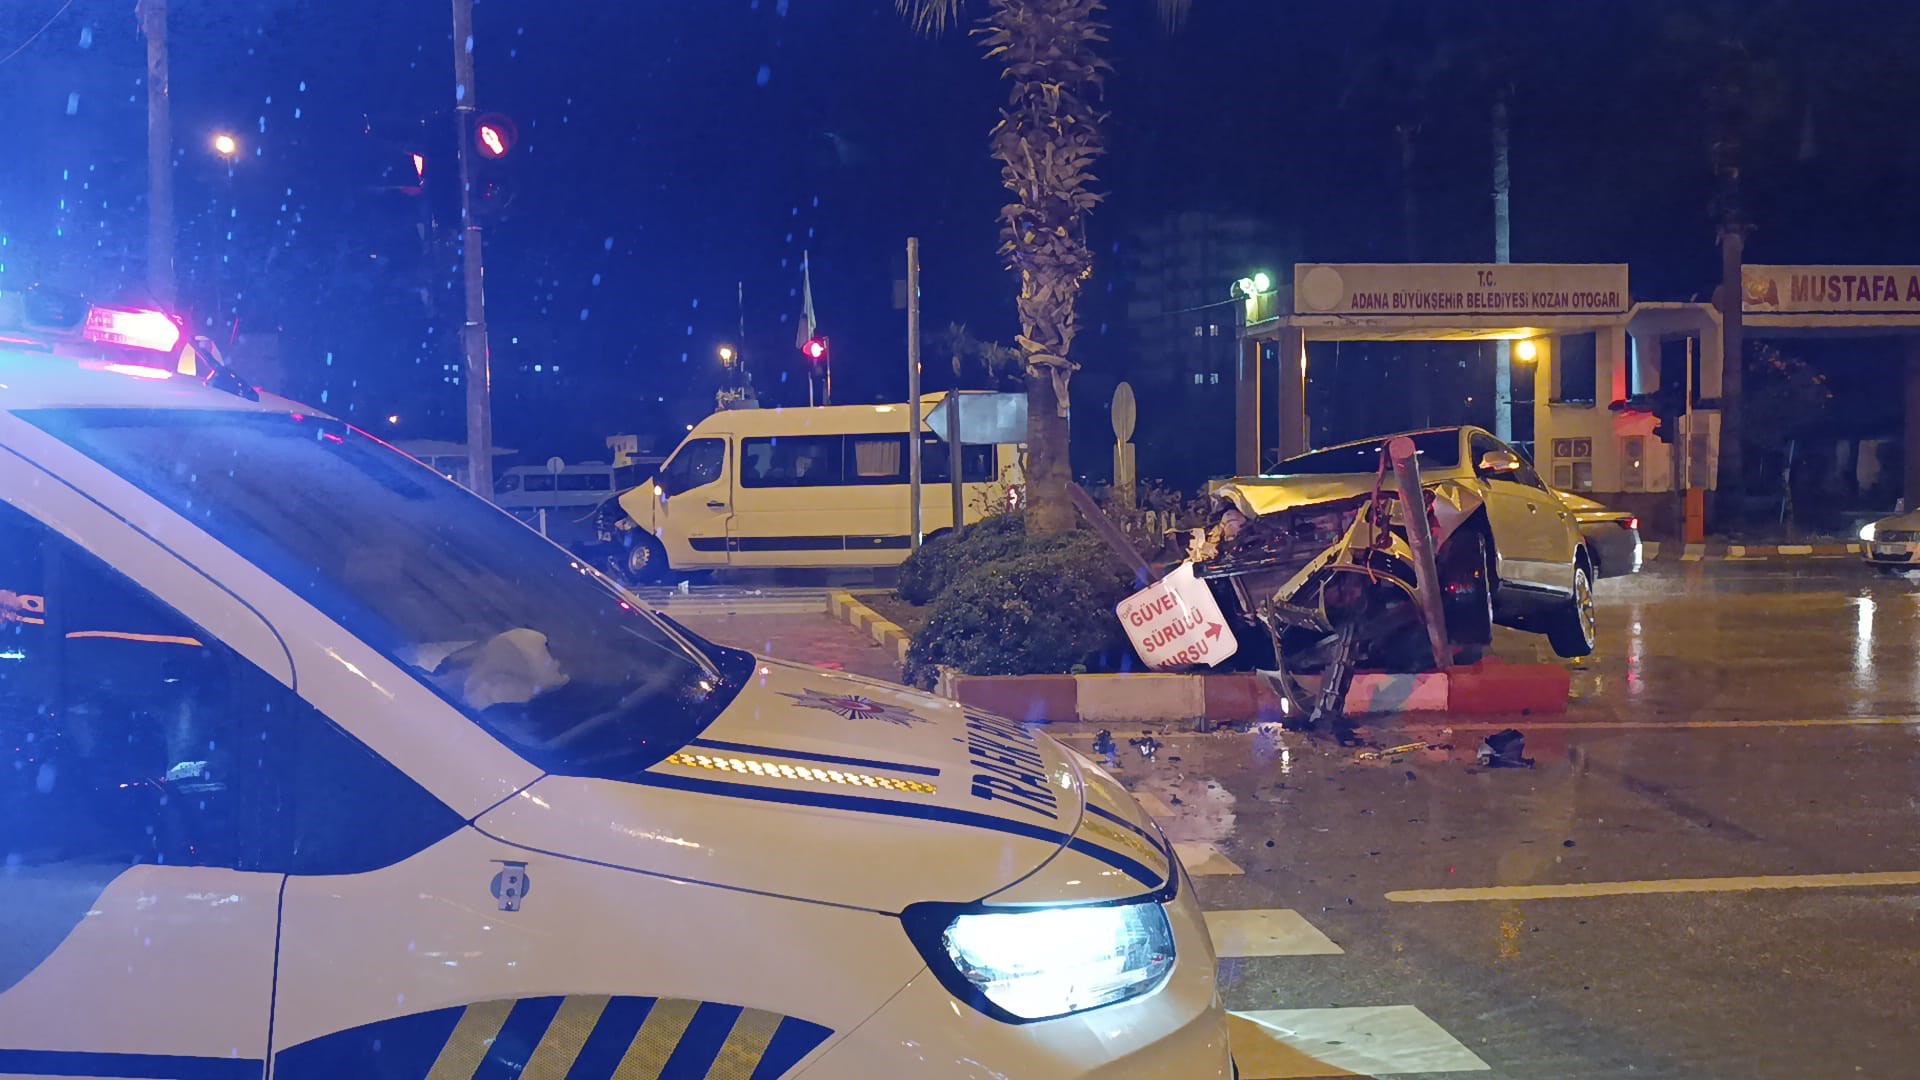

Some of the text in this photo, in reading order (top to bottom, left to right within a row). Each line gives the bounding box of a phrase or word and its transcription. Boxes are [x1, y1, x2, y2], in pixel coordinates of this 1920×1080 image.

[1477, 270, 1497, 287] T.C.
[1790, 274, 1899, 302] MUSTAFA
[1351, 292, 1390, 309] ADANA
[1531, 291, 1569, 309] KOZAN
[1572, 291, 1620, 309] OTOGARI
[1142, 606, 1204, 653] SÜRÜCÜ
